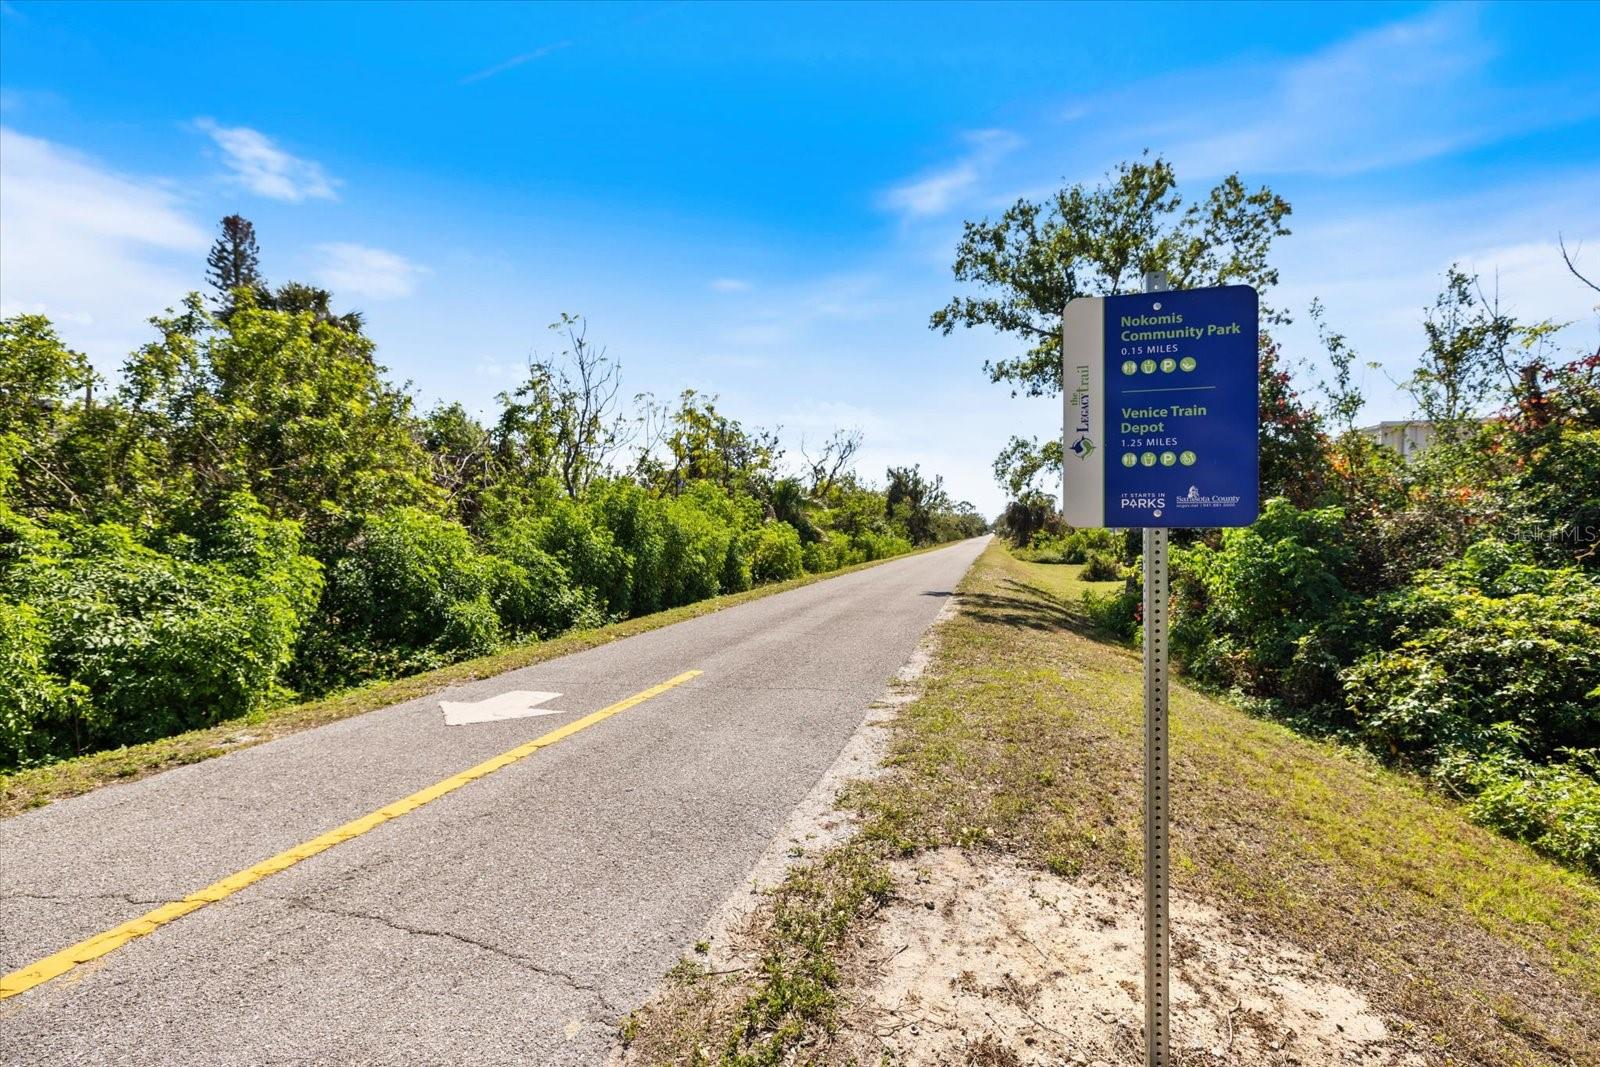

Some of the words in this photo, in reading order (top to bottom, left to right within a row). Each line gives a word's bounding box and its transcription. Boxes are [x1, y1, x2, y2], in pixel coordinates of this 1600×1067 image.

[1121, 313, 1183, 327] Nokomis
[1121, 327, 1204, 342] Community
[1207, 323, 1241, 336] Park
[1121, 347, 1143, 356] 0.15
[1147, 344, 1179, 354] MILES
[1121, 407, 1168, 419] Venice
[1170, 404, 1207, 417] Train
[1121, 422, 1165, 435] Depot
[1121, 439, 1142, 448] 1.25
[1146, 437, 1178, 447] MILES
[1121, 498, 1166, 509] PARKS
[1212, 495, 1241, 504] County
